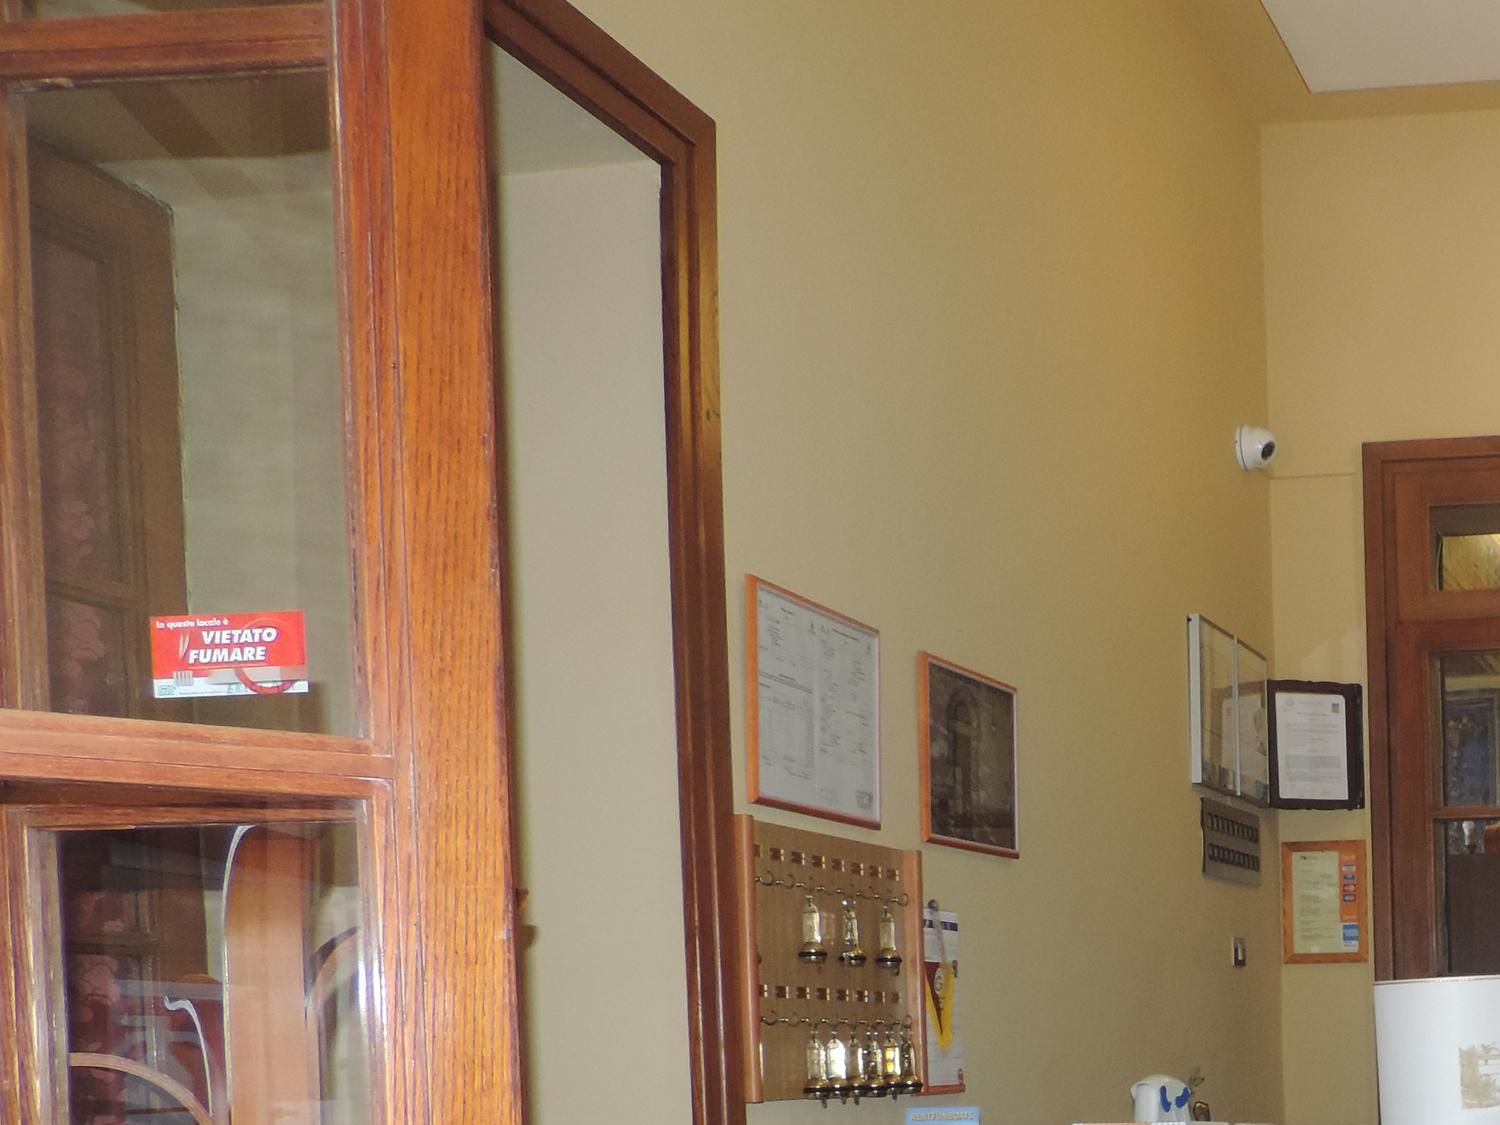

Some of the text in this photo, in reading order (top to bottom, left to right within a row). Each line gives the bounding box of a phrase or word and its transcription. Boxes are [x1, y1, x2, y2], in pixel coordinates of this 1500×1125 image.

[166, 620, 195, 631] questo
[196, 618, 221, 627] locale
[202, 627, 277, 645] VIETATO
[188, 646, 266, 664] FUMARE
